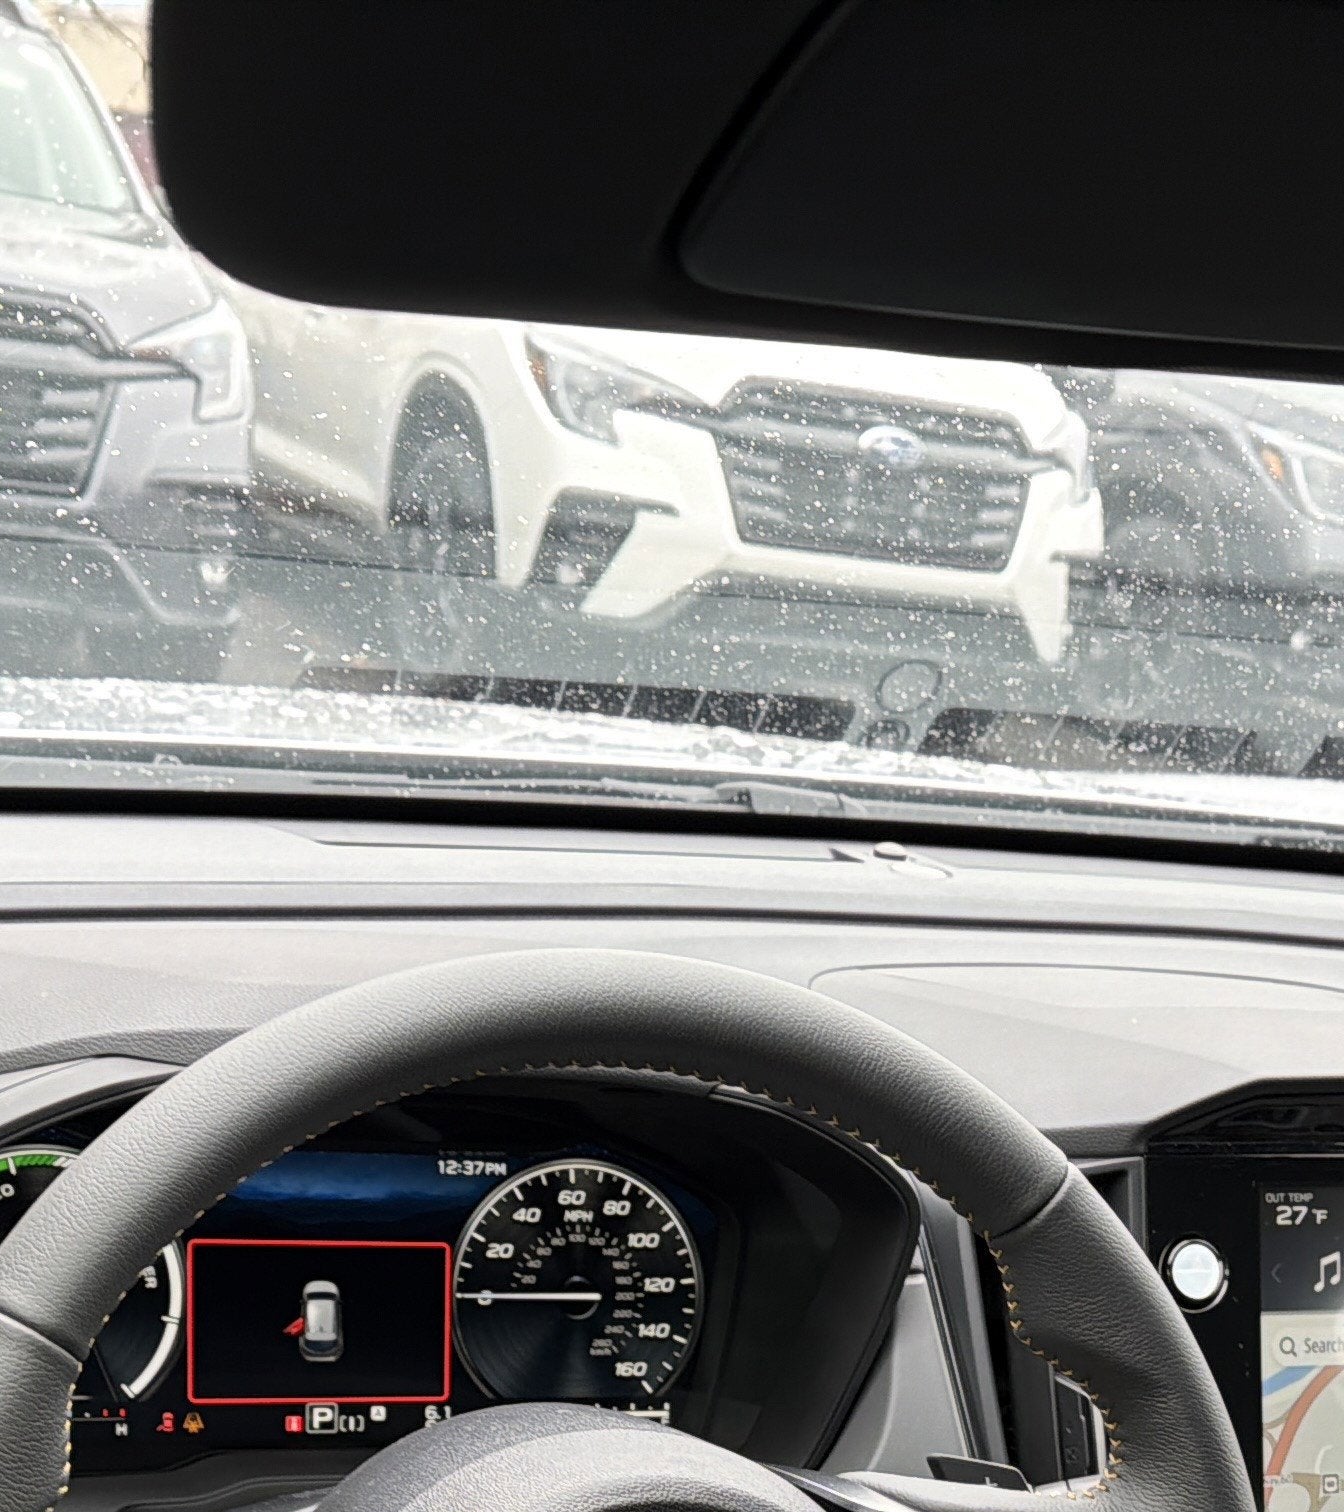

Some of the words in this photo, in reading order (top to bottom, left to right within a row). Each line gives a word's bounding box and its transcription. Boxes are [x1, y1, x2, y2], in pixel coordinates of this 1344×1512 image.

[558, 1189, 587, 1206] 60
[1265, 1193, 1285, 1203] OUT
[1288, 1193, 1313, 1203] TEMP
[512, 1207, 542, 1223] 40
[563, 1209, 594, 1223] MPH
[602, 1200, 632, 1216] 80
[627, 1233, 660, 1249] 100
[486, 1243, 514, 1259] 20
[644, 1278, 675, 1293] 120
[639, 1322, 671, 1339] 140
[615, 1361, 648, 1377] 160
[313, 1407, 333, 1429] P
